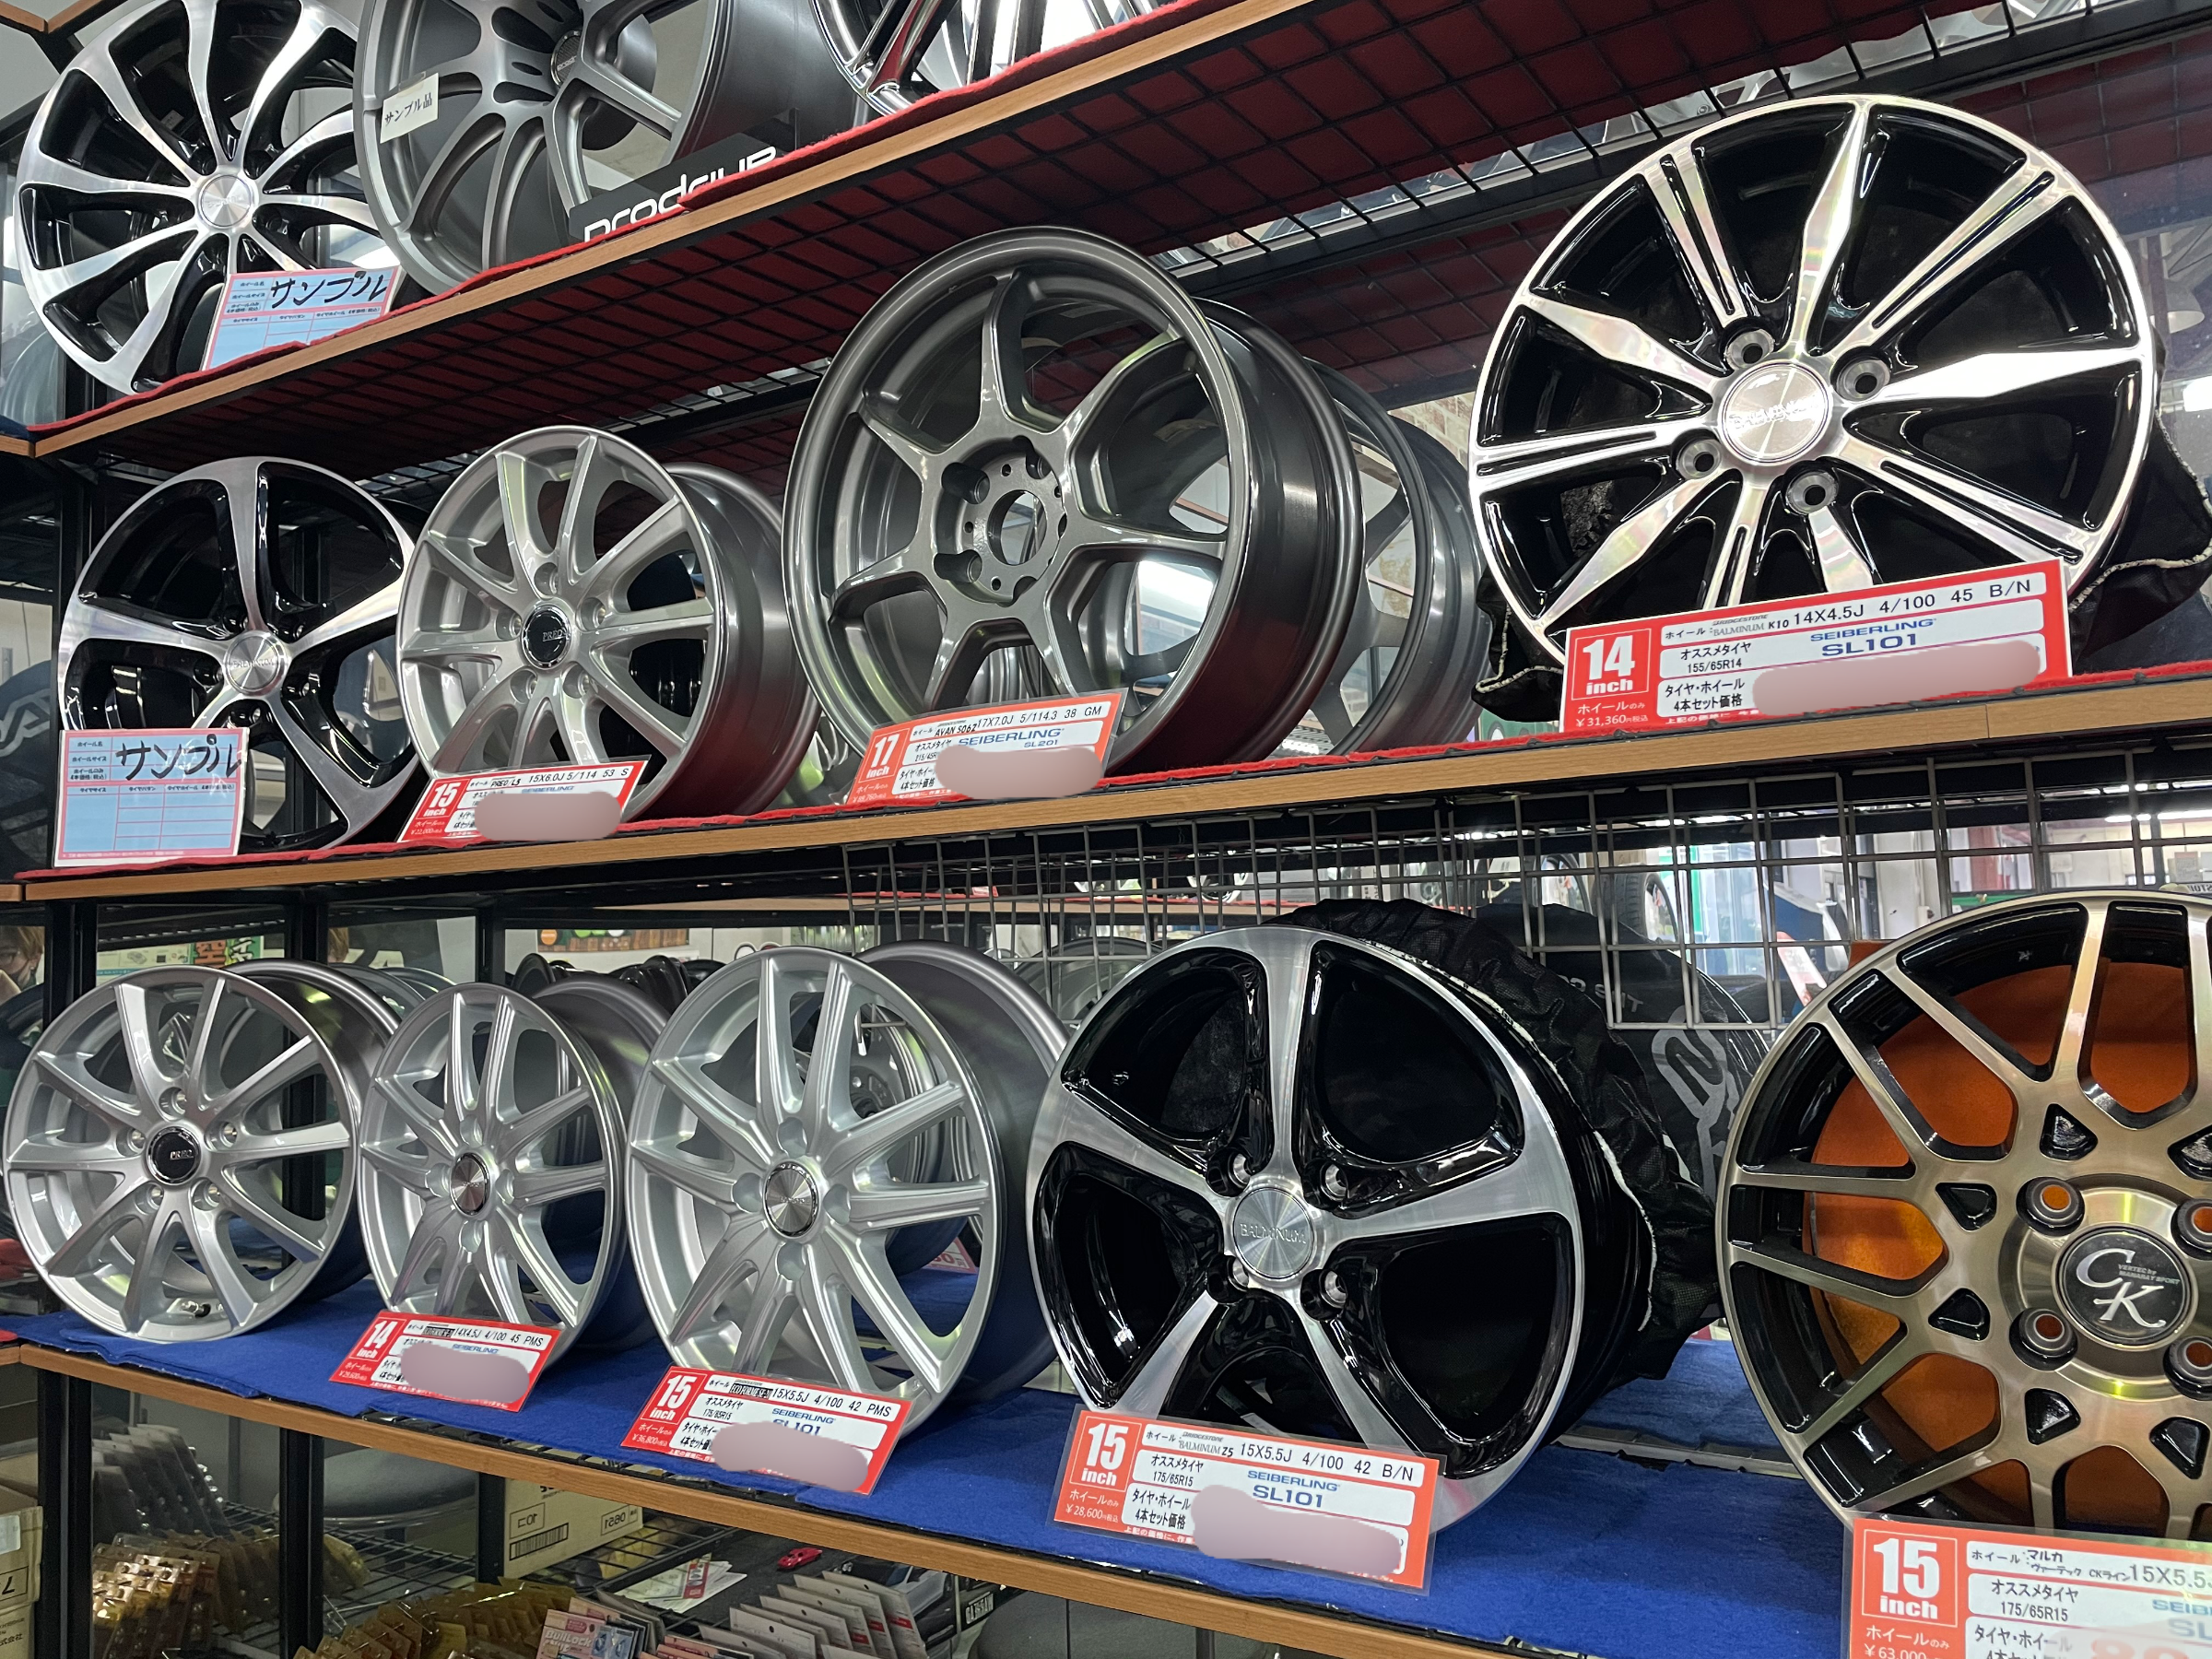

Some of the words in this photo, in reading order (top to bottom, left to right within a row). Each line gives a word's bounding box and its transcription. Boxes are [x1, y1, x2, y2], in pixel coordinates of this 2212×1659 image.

[1713, 623, 1765, 637] BALMINUM
[1768, 618, 1790, 630] K10
[1794, 604, 1864, 625] 14X4.5J
[1879, 594, 1936, 614] 4/100
[1951, 588, 1973, 603] 45
[1990, 579, 2030, 598] B/N
[1810, 618, 1934, 641] SEIBERLING
[1680, 642, 1751, 661] オススメタイヤ
[1821, 634, 1916, 657] SL101
[1583, 635, 1635, 680] 14
[1687, 657, 1742, 674] 155/65R14
[1585, 678, 1633, 696] inch
[1665, 677, 1745, 698] タイヤ・ホイール
[1577, 700, 1645, 715] ホイールのみ
[1674, 693, 1742, 712] 4本セット価格
[977, 715, 1013, 729] 17X7.0J
[1019, 711, 1058, 724] 5/114.3
[1065, 709, 1077, 719] 38
[1084, 705, 1101, 716] GM
[915, 738, 951, 751] オススメタイヤ
[959, 728, 1061, 746] SEIBERLING
[1023, 739, 1058, 748] SL201
[115, 734, 241, 781] サンプル
[875, 734, 900, 768] 17
[528, 772, 565, 783] 15X6.0J
[567, 770, 596, 781] 5/114
[602, 769, 616, 778] 53
[620, 768, 629, 776] S
[866, 766, 889, 779] inch
[900, 767, 936, 781] タイヤ・ホイー
[429, 782, 462, 808] 15
[423, 808, 446, 817] inch
[364, 1320, 398, 1349] 14
[453, 1326, 481, 1338] 14X4.5J
[485, 1331, 507, 1341] 4/100
[510, 1334, 520, 1343] 45
[524, 1336, 544, 1347] PMS
[357, 1348, 378, 1359] inch
[660, 1374, 696, 1410] 15
[772, 1387, 808, 1403] 15X5.5J
[814, 1394, 843, 1408] 4/100
[849, 1401, 862, 1412] 42
[867, 1404, 892, 1417] PMS
[705, 1396, 744, 1410] オススメタイヤ
[649, 1407, 676, 1421] inch
[771, 1407, 834, 1424] SEIBERLING
[682, 1422, 717, 1437] タイヤ・ホイー
[1086, 1422, 1129, 1471] 15
[1151, 1453, 1204, 1473] オススメタイヤ
[1179, 1441, 1221, 1454] BALMINUM
[1222, 1446, 1233, 1458] Z5
[1241, 1442, 1292, 1463] 15X5.5J
[1301, 1452, 1344, 1470] 4/100
[1354, 1460, 1371, 1475] 42
[1382, 1464, 1414, 1481] B/N
[1081, 1467, 1117, 1487] inch
[1153, 1471, 1194, 1488] 175/65R15
[1247, 1470, 1338, 1492] SEIBERLING
[1069, 1488, 1119, 1508] ホイールのみ
[1133, 1488, 1192, 1511] タイヤ・ホイール
[1253, 1485, 1324, 1508] SL101
[1135, 1508, 1186, 1530] 4本セット価格
[2027, 1549, 2063, 1562] マルカ
[1874, 1537, 1940, 1598] 15
[2130, 1564, 2212, 1588] 15X5.5
[1992, 1579, 2078, 1603] オススメタイヤ
[1880, 1595, 1938, 1620] inch
[2001, 1601, 2068, 1622] 175/65R15
[2152, 1599, 2212, 1616] SEIB
[1865, 1624, 1950, 1650] ホイールのみ
